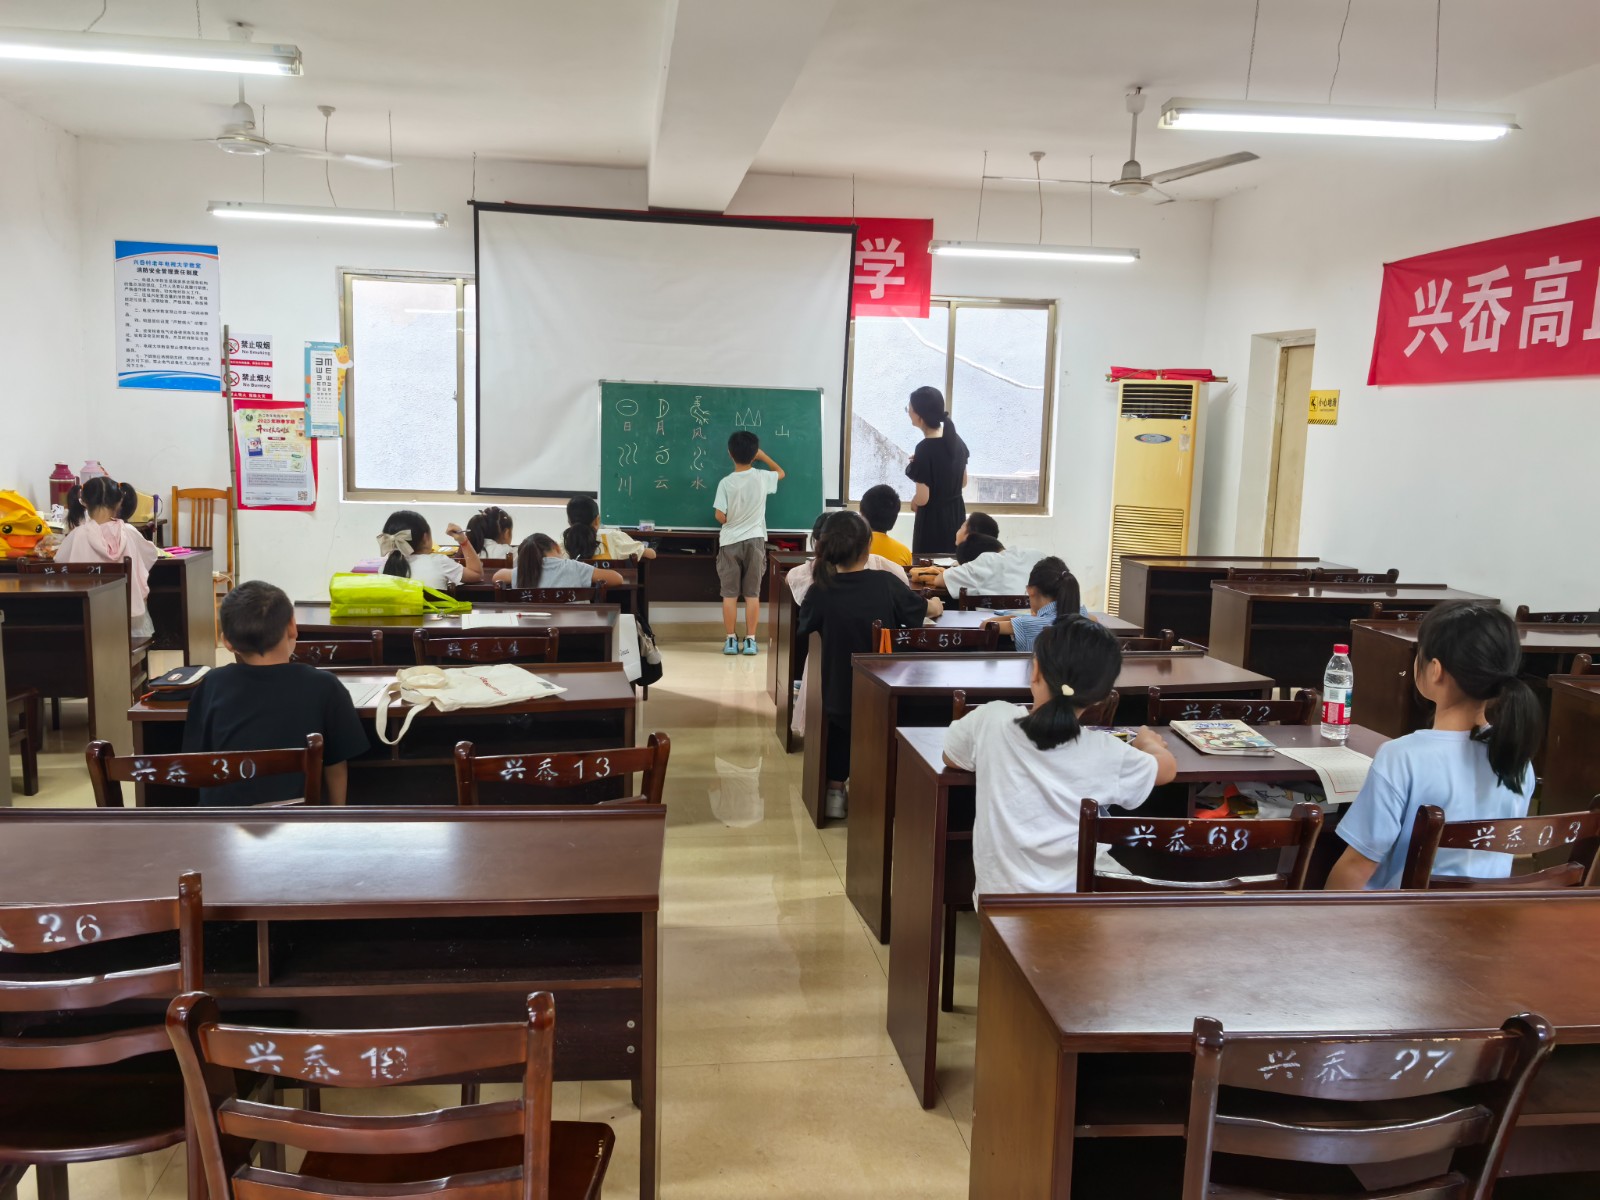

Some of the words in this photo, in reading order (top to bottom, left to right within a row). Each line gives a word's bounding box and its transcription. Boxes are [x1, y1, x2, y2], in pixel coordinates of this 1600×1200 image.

[854, 237, 905, 299] 学
[241, 340, 271, 350] 禁止吸烟
[242, 373, 271, 383] 禁止烟火
[623, 421, 632, 432] 日
[656, 420, 665, 436] 月
[775, 425, 790, 438] 山
[617, 475, 632, 496] 川
[654, 475, 669, 489] 云
[690, 476, 707, 490] 水
[939, 632, 962, 648] 58
[1241, 704, 1271, 722] 22
[212, 758, 257, 779] 30
[573, 757, 611, 780] 13
[1208, 826, 1249, 851] 68
[1537, 821, 1581, 846] 03
[38, 914, 102, 943] 26
[1390, 1048, 1454, 1081] 27
